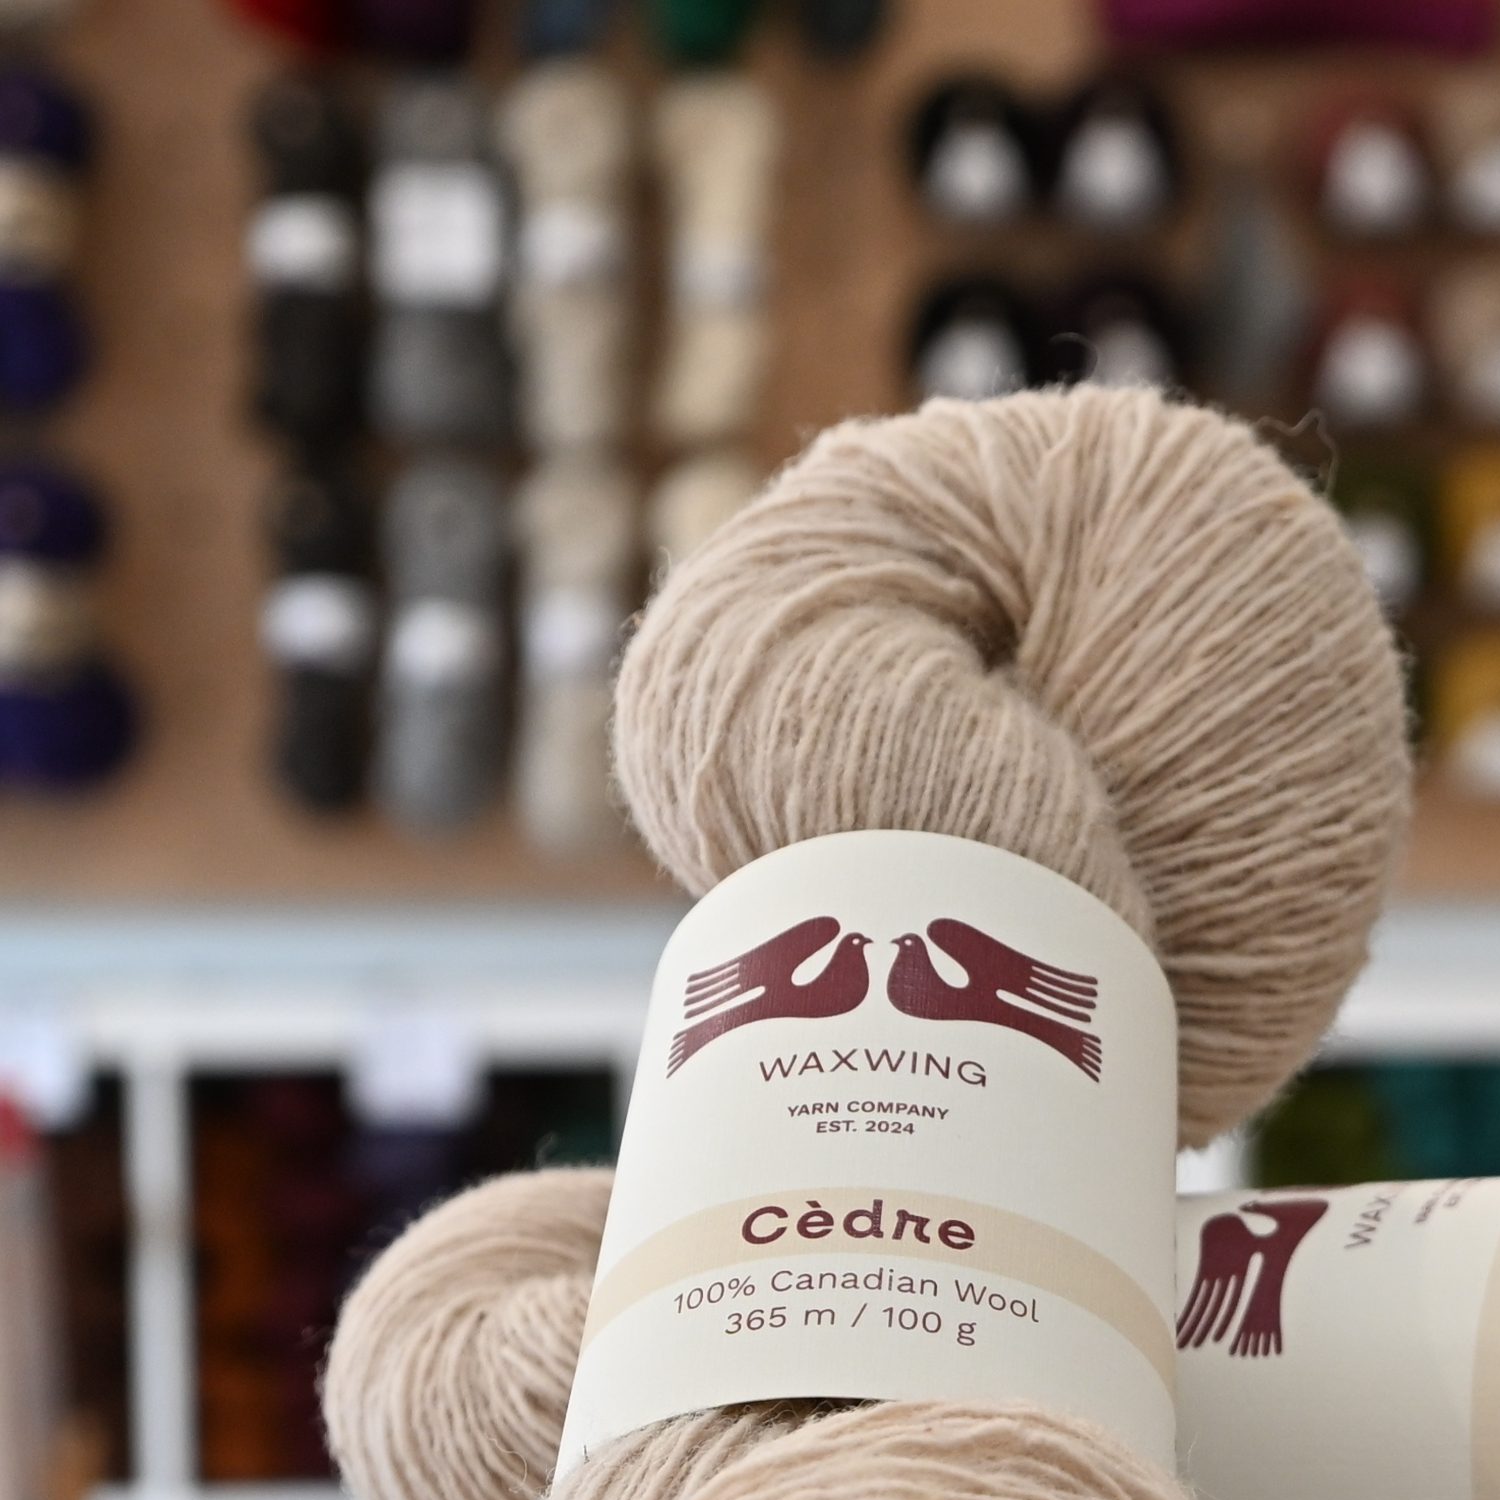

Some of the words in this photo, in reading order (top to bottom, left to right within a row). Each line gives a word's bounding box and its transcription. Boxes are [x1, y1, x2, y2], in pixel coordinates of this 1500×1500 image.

[759, 1048, 987, 1087] WAXWING
[787, 1102, 840, 1118] YARN
[846, 1101, 949, 1120] COMPANY
[815, 1120, 858, 1134] EST.
[864, 1120, 915, 1135] 2024
[741, 1199, 976, 1251] Cèdre
[673, 1275, 756, 1314] 100%
[770, 1267, 938, 1297] Canadian
[954, 1278, 1040, 1323] Wool
[724, 1305, 787, 1335] 365
[803, 1307, 836, 1326] m
[850, 1303, 868, 1328] /
[881, 1306, 942, 1333] 100
[956, 1321, 978, 1346] g
